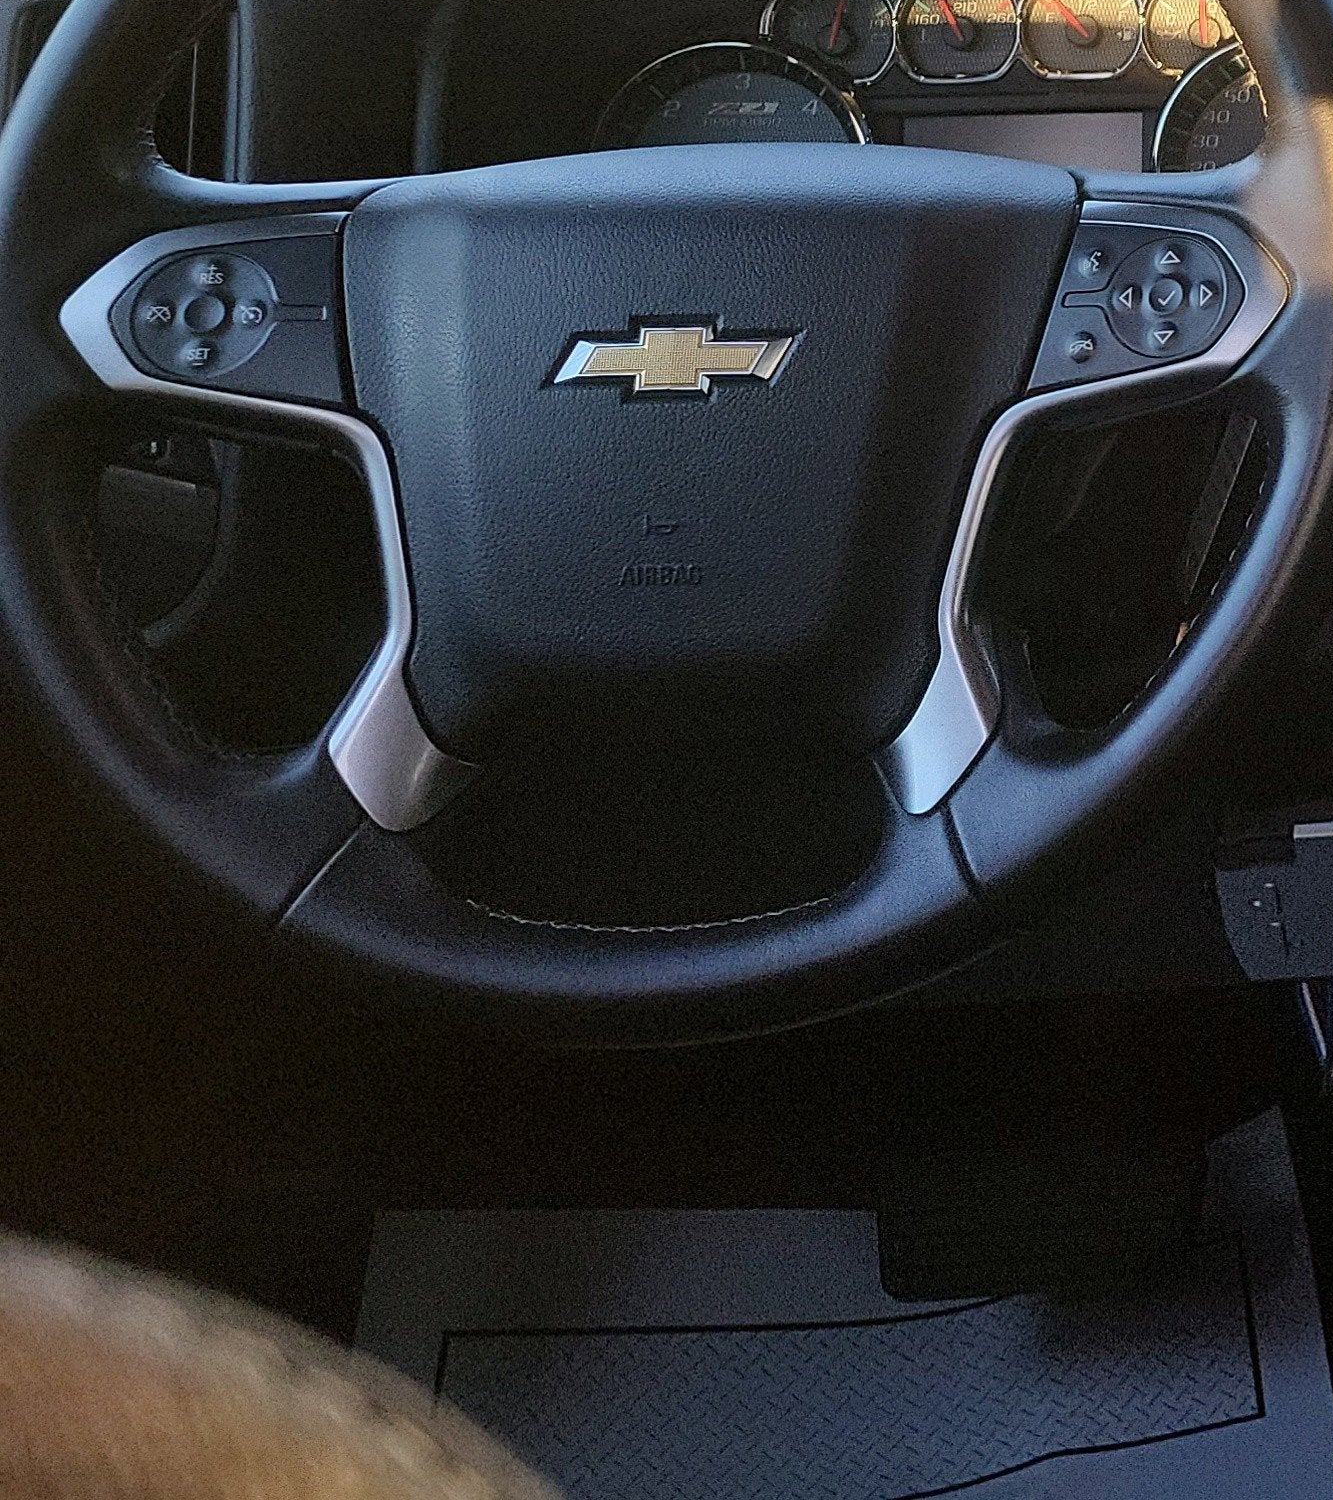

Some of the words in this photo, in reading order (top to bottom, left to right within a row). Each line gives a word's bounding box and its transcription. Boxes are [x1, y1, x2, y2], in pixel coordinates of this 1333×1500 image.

[914, 13, 940, 26] 160
[986, 12, 1017, 24] 260
[735, 73, 751, 90] 3
[1224, 89, 1250, 103] 50
[662, 101, 680, 118] 2
[802, 99, 818, 116] 4
[1203, 110, 1230, 123] 40
[199, 272, 225, 285] RES
[186, 347, 211, 361] SET
